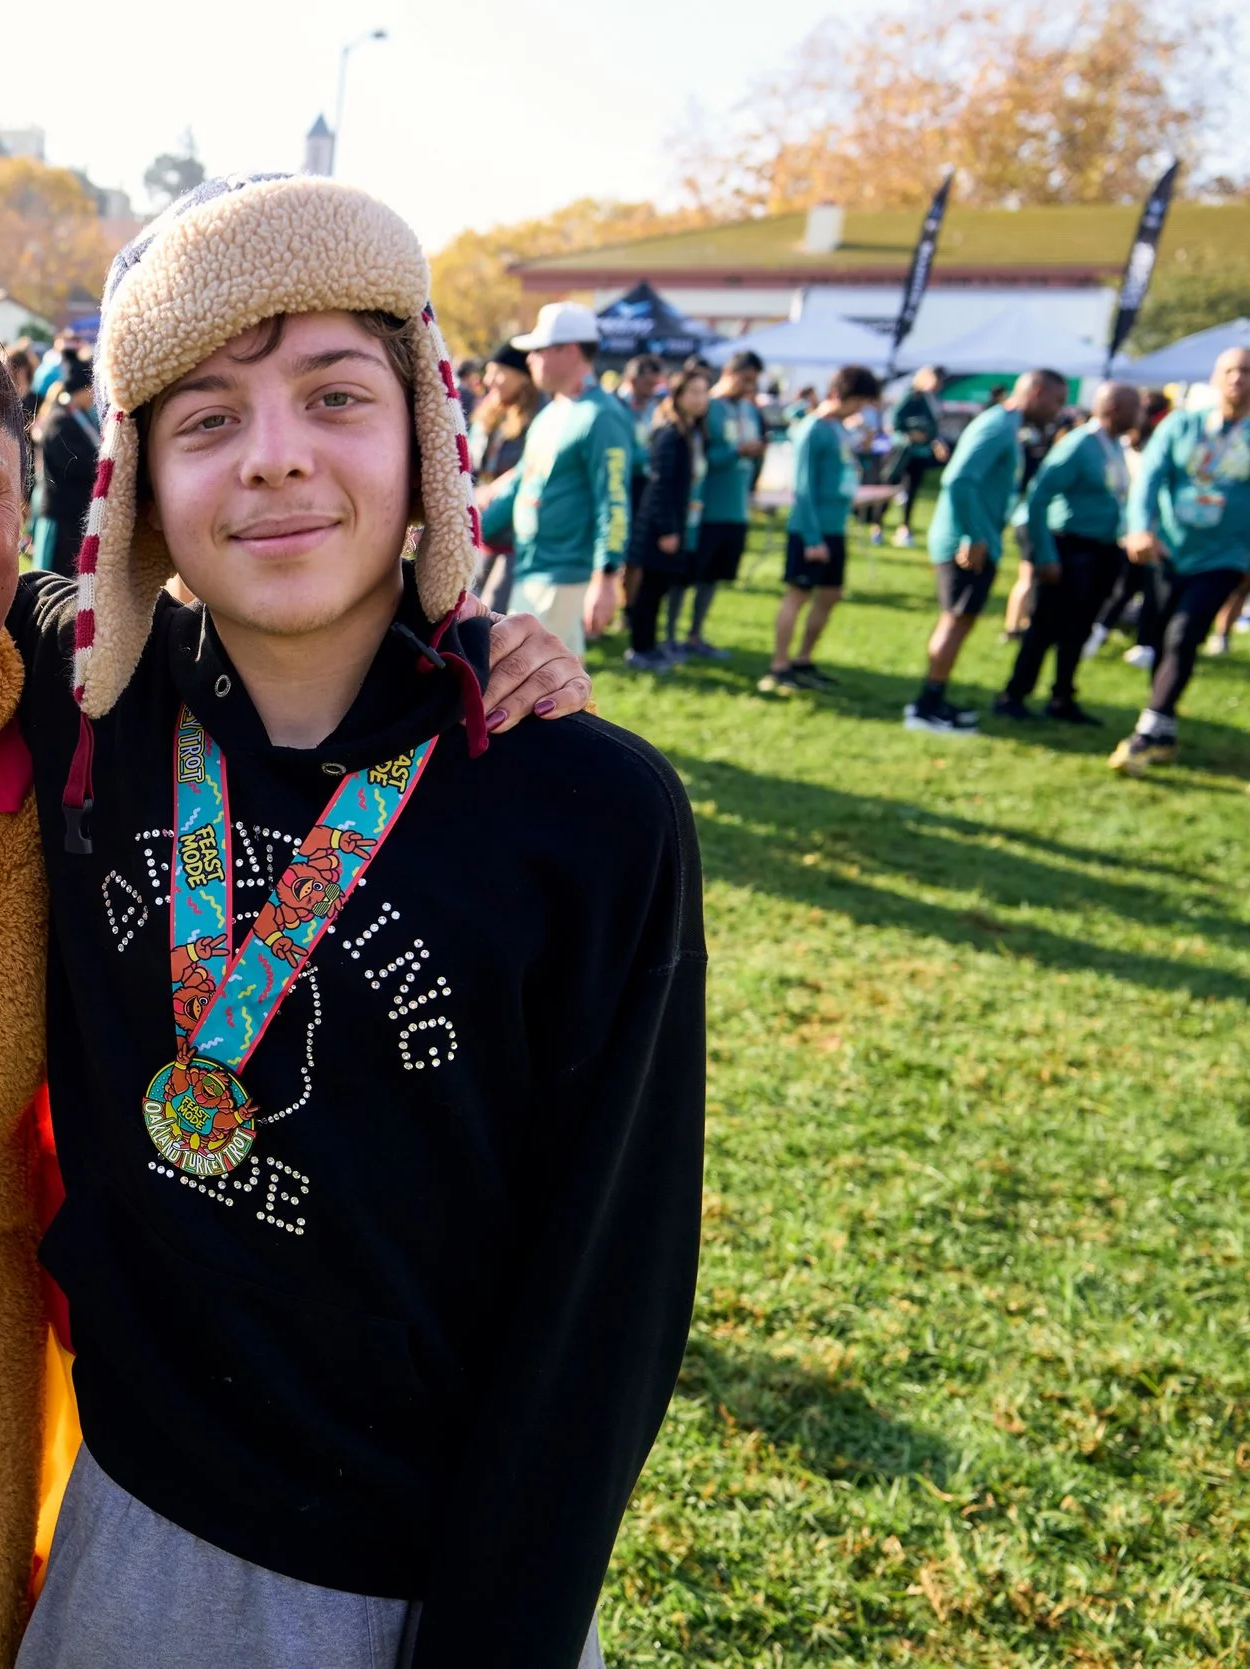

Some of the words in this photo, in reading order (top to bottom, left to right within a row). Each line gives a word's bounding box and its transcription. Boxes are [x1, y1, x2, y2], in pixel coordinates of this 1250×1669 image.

[179, 731, 203, 781] TROT
[369, 760, 393, 787] DE
[388, 749, 414, 792] AST
[179, 834, 208, 889] MODE
[196, 824, 225, 882] FEAST
[177, 1105, 205, 1129] MODE
[184, 1096, 210, 1121] FEAST
[145, 1102, 180, 1161] OAKLAND
[182, 1151, 226, 1174] TURKEY
[223, 1128, 252, 1165] TROT
